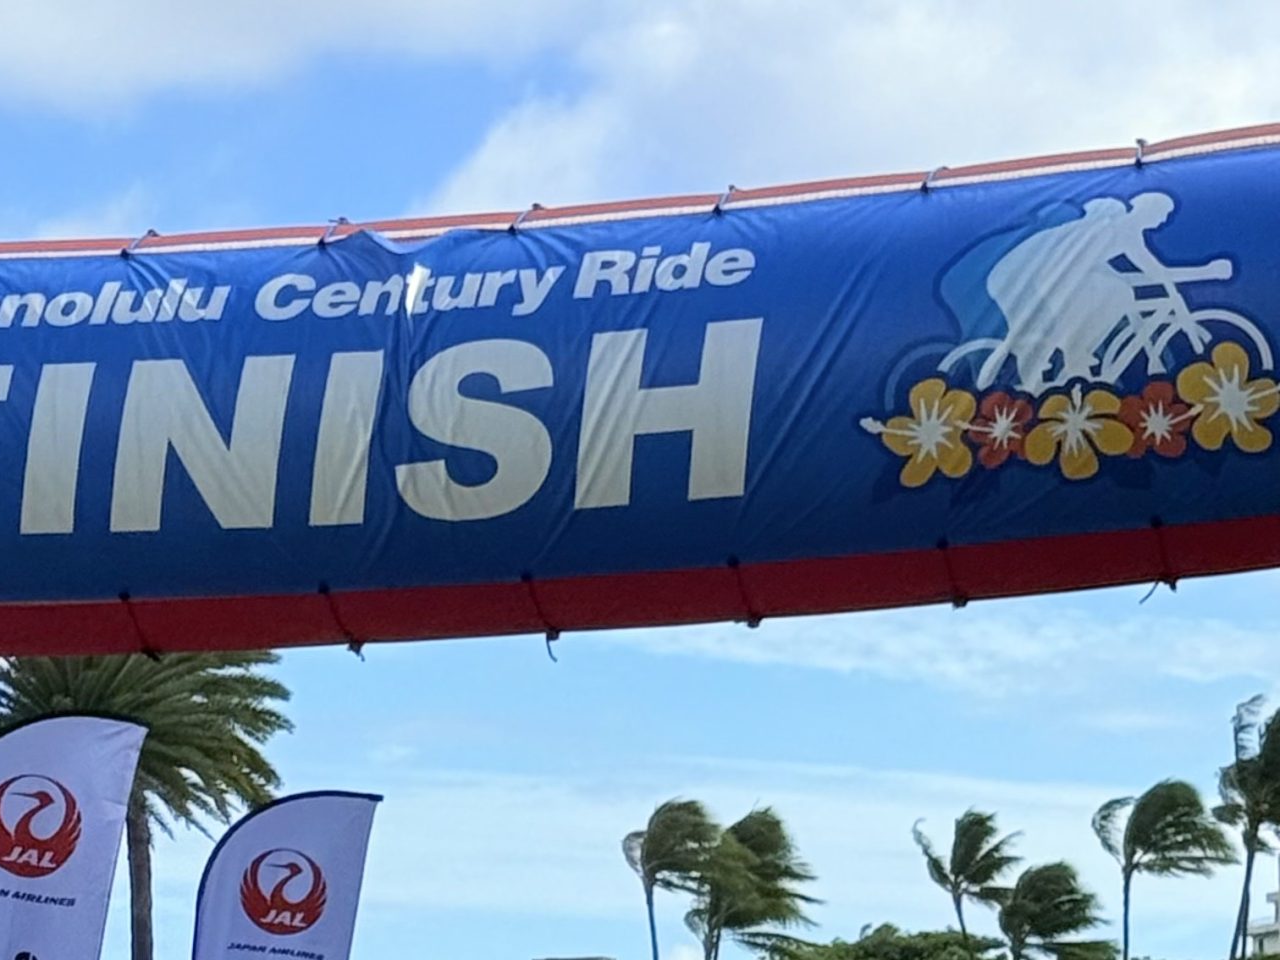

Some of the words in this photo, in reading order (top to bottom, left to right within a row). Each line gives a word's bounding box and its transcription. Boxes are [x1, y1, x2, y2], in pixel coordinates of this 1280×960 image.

[254, 264, 566, 320] Century
[573, 242, 756, 299] Ride
[1, 846, 56, 868] JAL
[11, 892, 76, 907] AIRLINES
[260, 909, 308, 927] JAL
[227, 943, 267, 953] JAPAN
